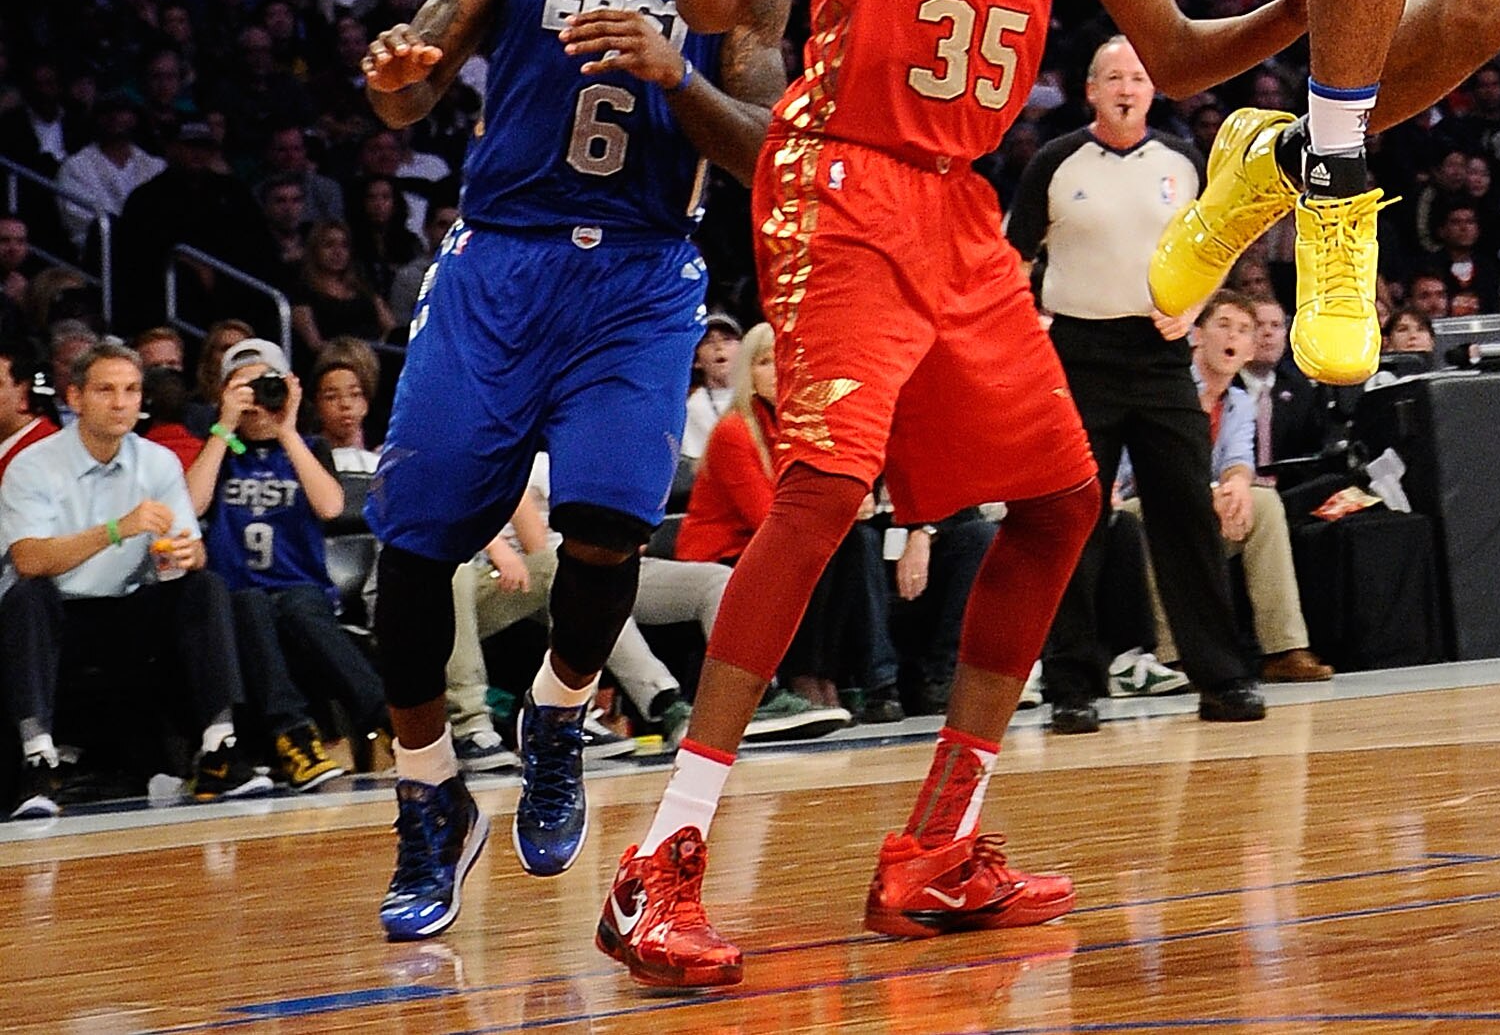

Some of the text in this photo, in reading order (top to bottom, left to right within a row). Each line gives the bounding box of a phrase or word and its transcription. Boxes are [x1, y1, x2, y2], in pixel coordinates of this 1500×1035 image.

[566, 83, 636, 176] 6
[224, 477, 298, 507] EAST
[244, 521, 274, 571] 9
